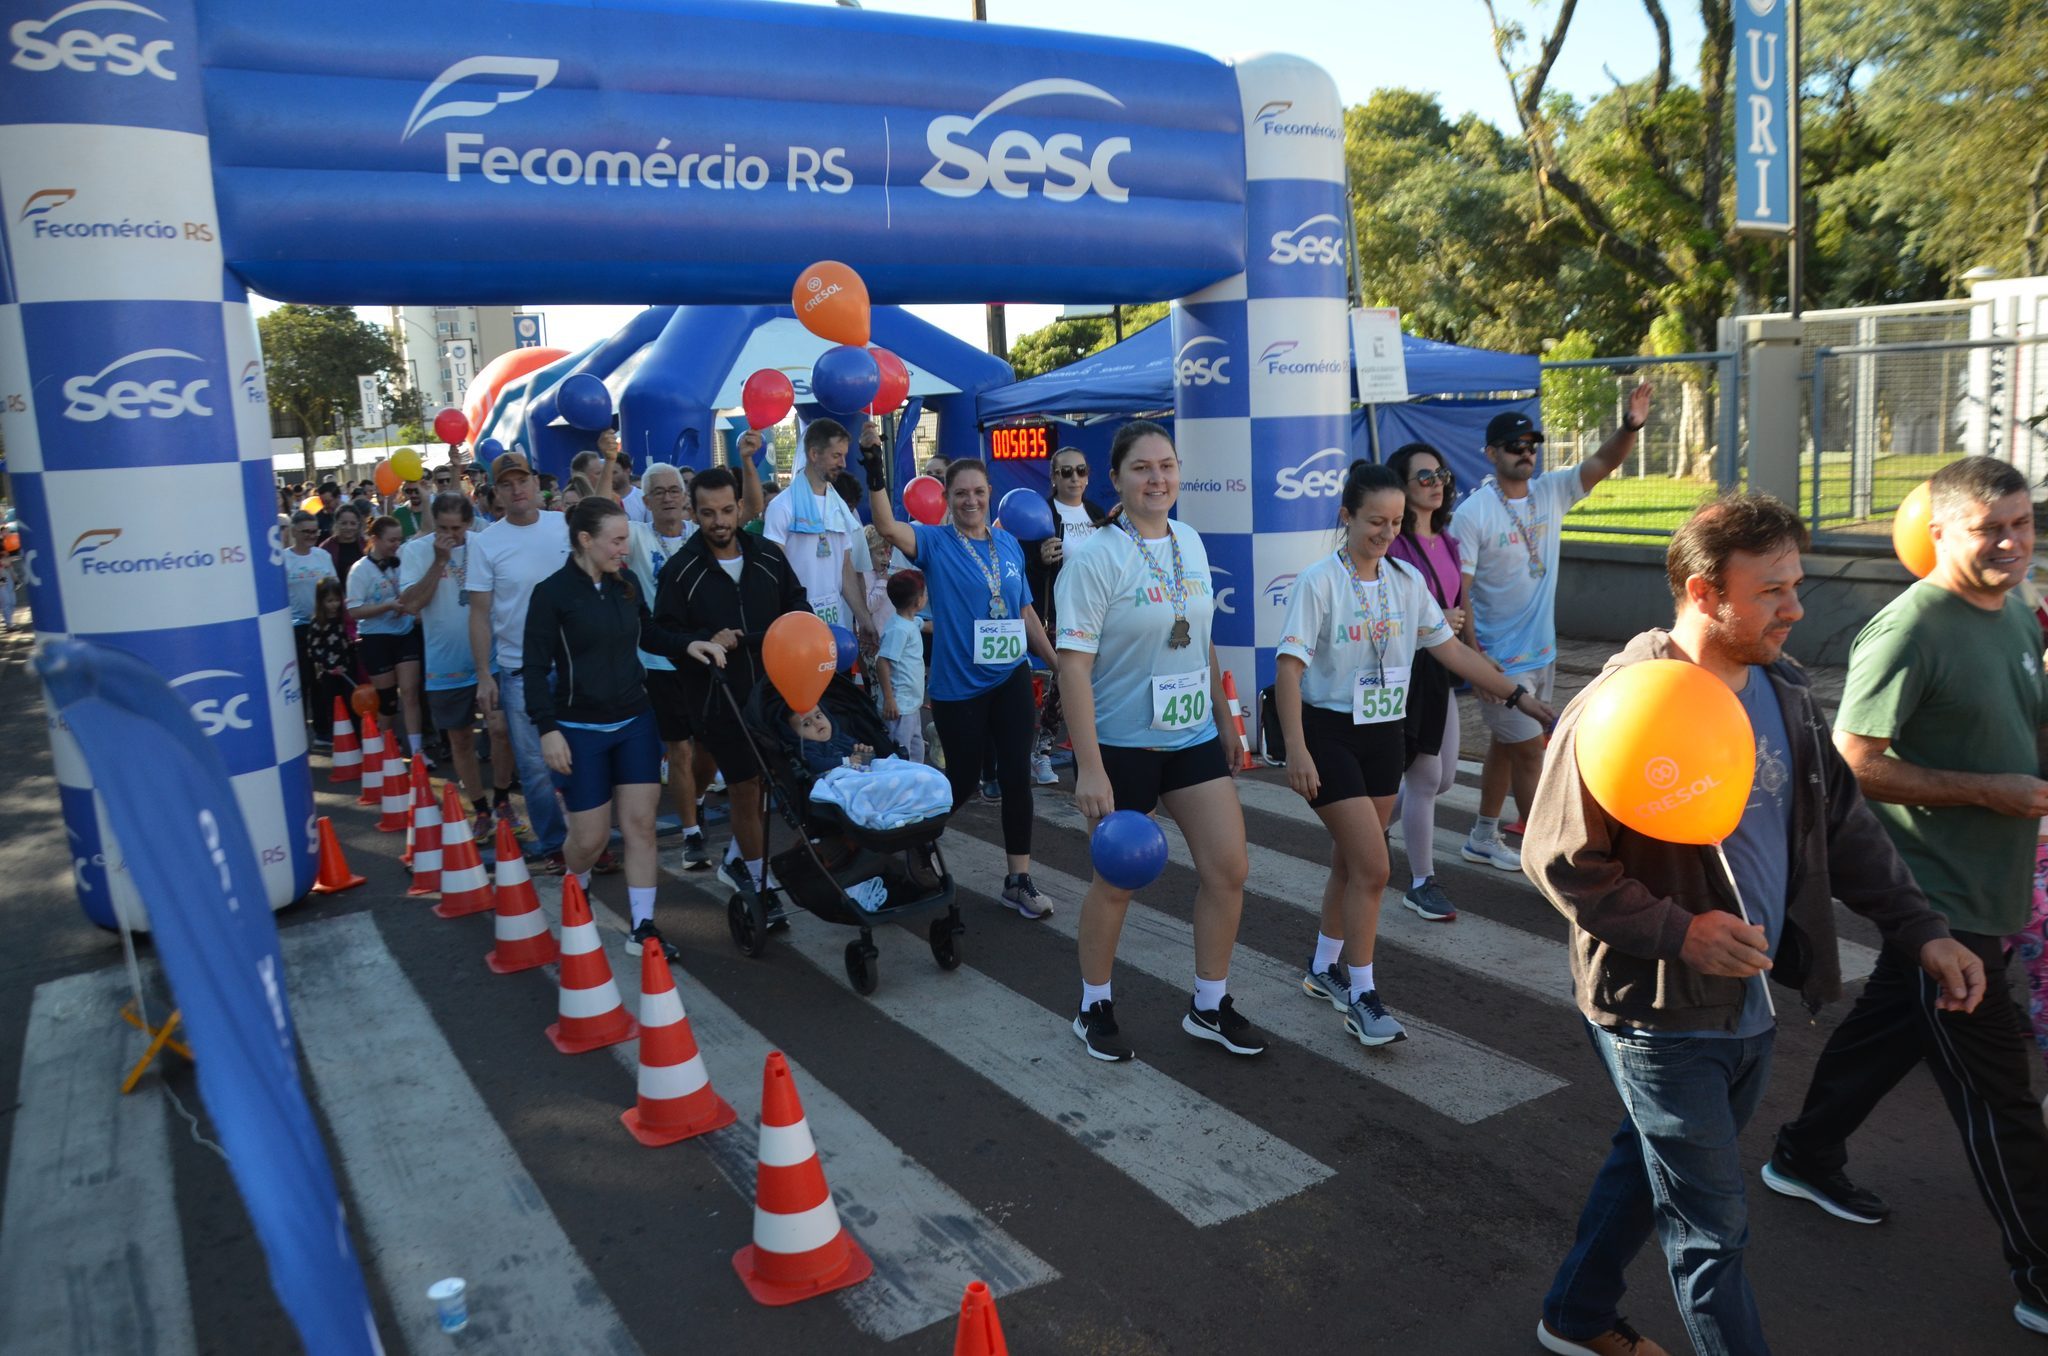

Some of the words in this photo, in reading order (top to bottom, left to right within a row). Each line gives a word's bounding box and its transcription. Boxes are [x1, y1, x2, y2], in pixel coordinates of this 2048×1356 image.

[10, 19, 178, 81] Sesc
[1745, 28, 1779, 218] URI
[445, 131, 770, 191] Fecomércio
[787, 146, 854, 194] RS
[920, 114, 1132, 203] Sesc
[33, 218, 178, 240] Fecomércio
[183, 221, 215, 242] RS
[804, 283, 843, 312] CRESOL
[62, 374, 214, 422] Sesc
[364, 392, 376, 425] URI
[1179, 478, 1222, 492] omércio
[1225, 479, 1247, 492] RS
[82, 551, 215, 576] Fecomércio
[220, 545, 248, 566] RS
[982, 635, 1021, 660] 520
[1162, 689, 1206, 727] 430
[1240, 705, 1252, 718] S
[1361, 686, 1406, 719] 552
[1634, 774, 1722, 820] CRESOL
[261, 844, 287, 866] RS
